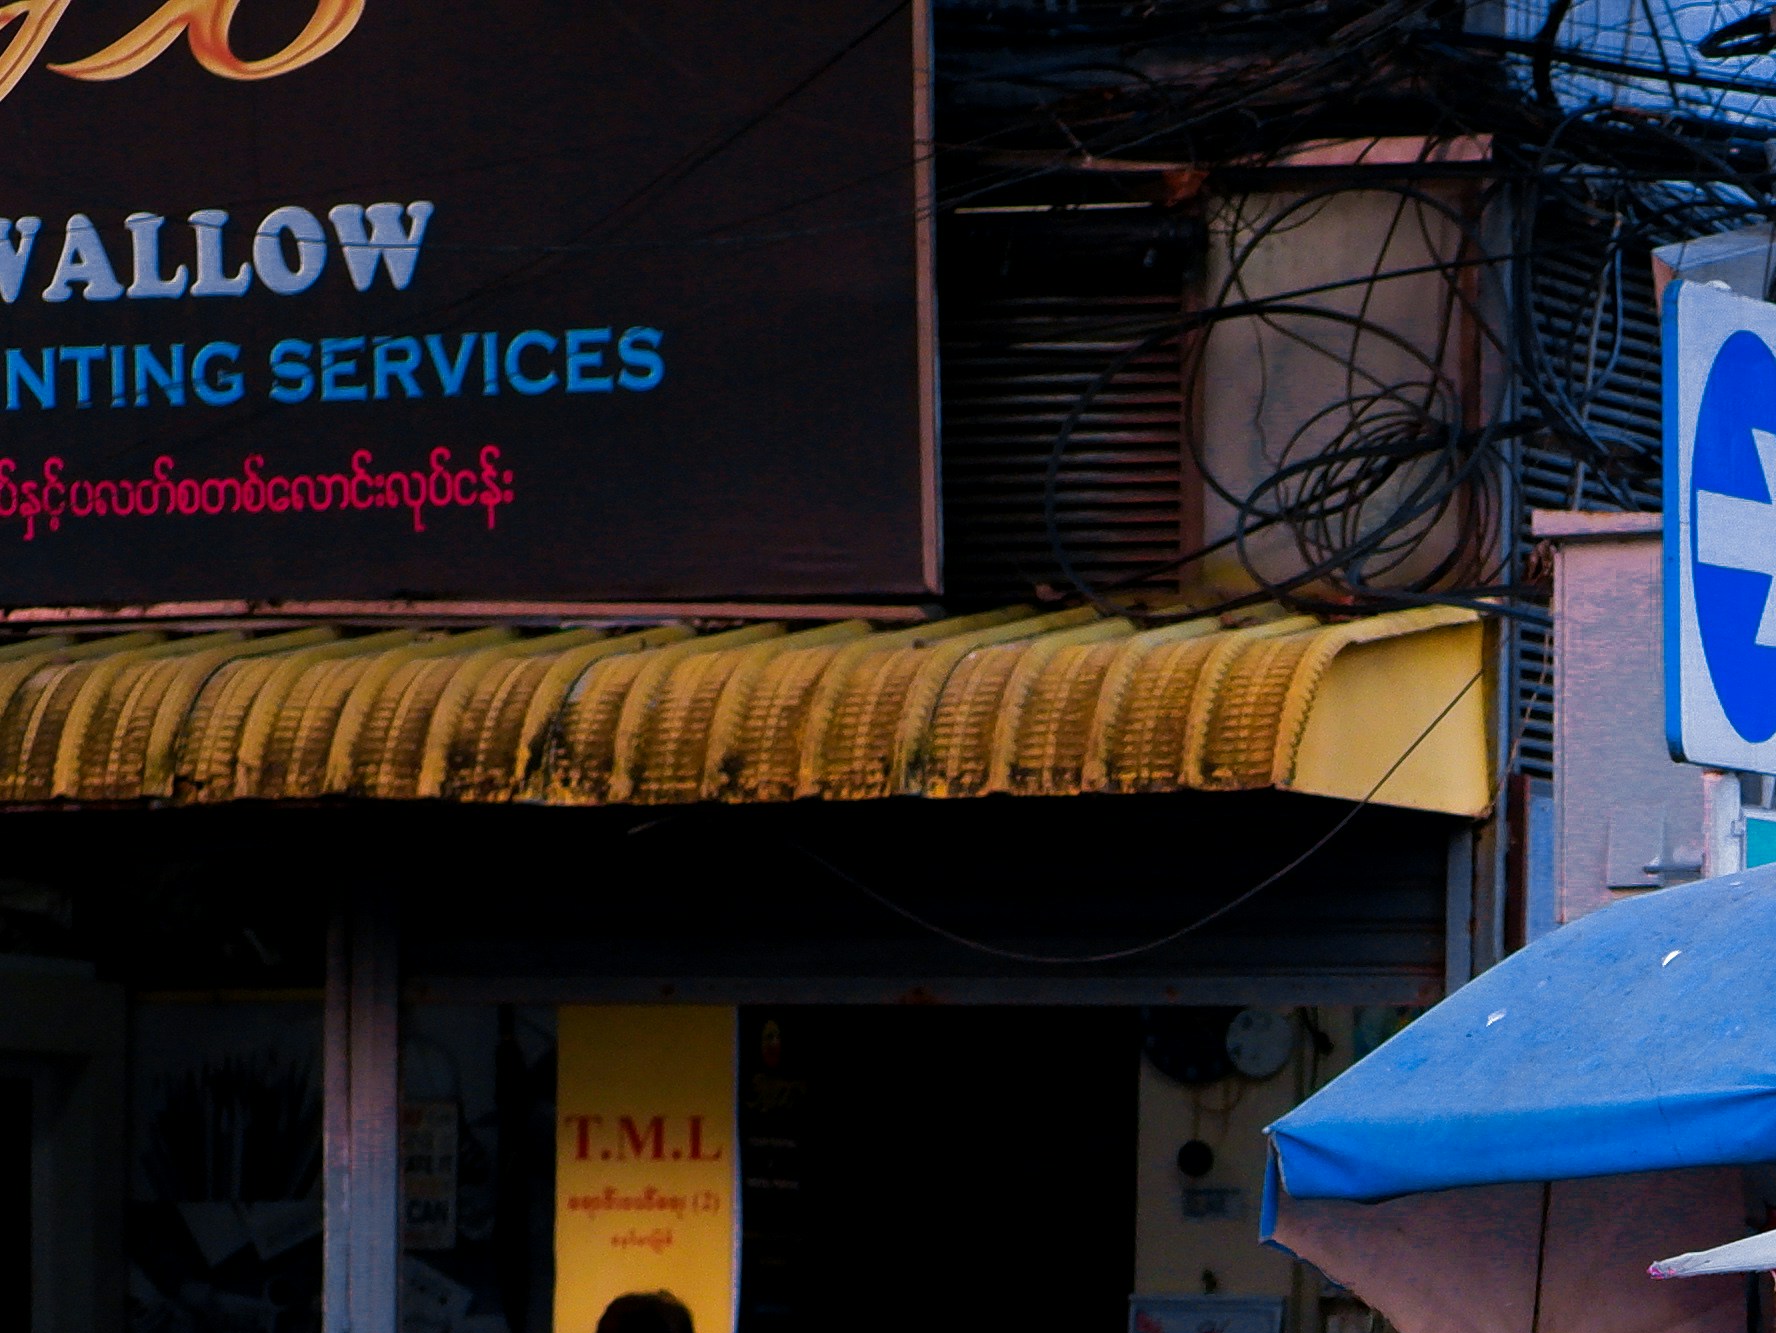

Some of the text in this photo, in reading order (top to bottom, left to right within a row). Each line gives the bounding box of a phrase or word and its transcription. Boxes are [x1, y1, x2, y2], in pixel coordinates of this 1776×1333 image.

[3, 326, 667, 411] NTING SERVICES
[563, 1113, 723, 1162] T.M.L
